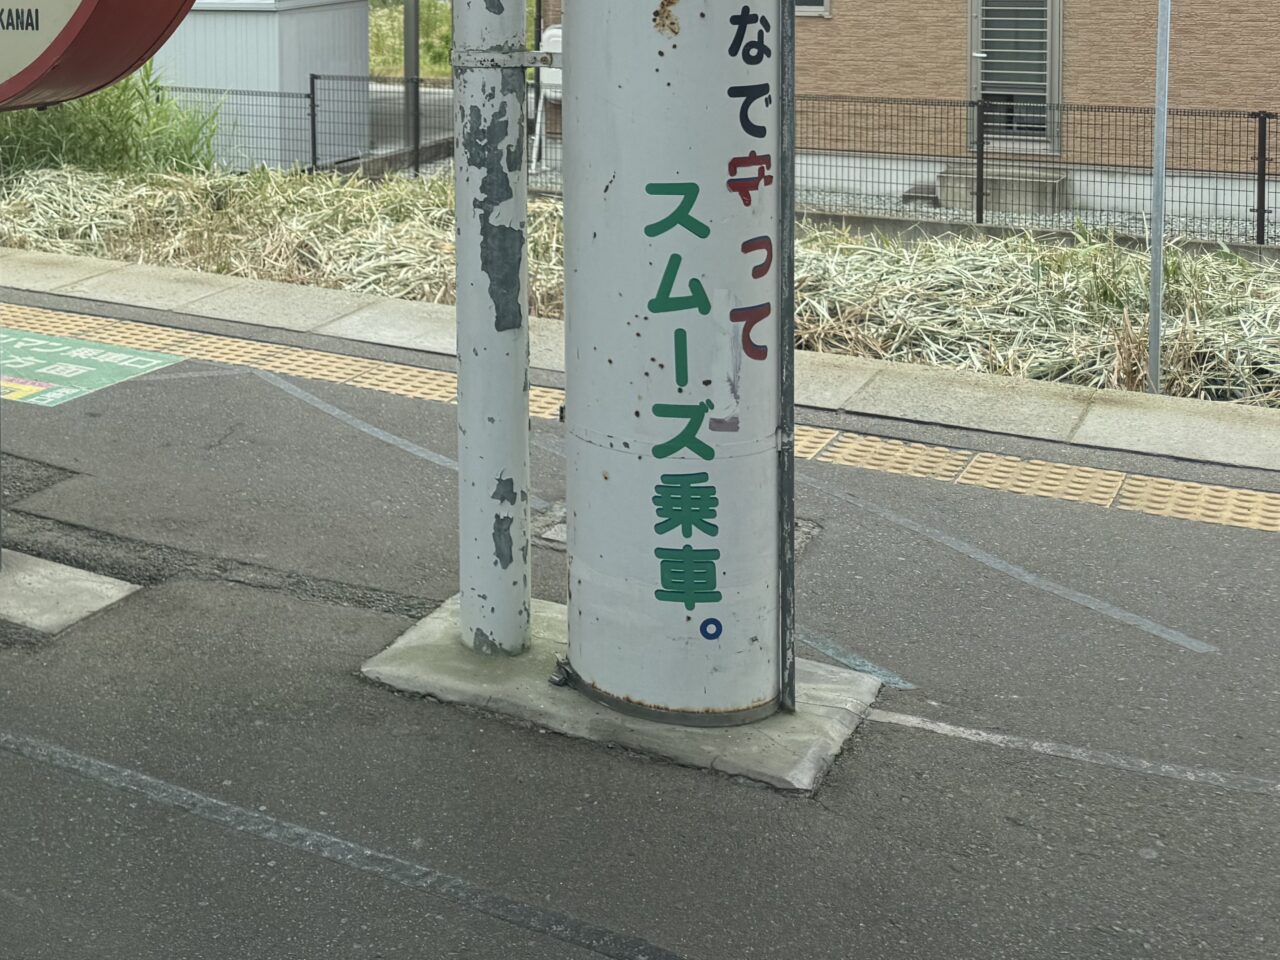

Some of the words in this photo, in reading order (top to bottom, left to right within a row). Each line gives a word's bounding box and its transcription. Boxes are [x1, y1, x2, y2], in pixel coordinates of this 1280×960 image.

[644, 182, 723, 641] スムーズ乗車。
